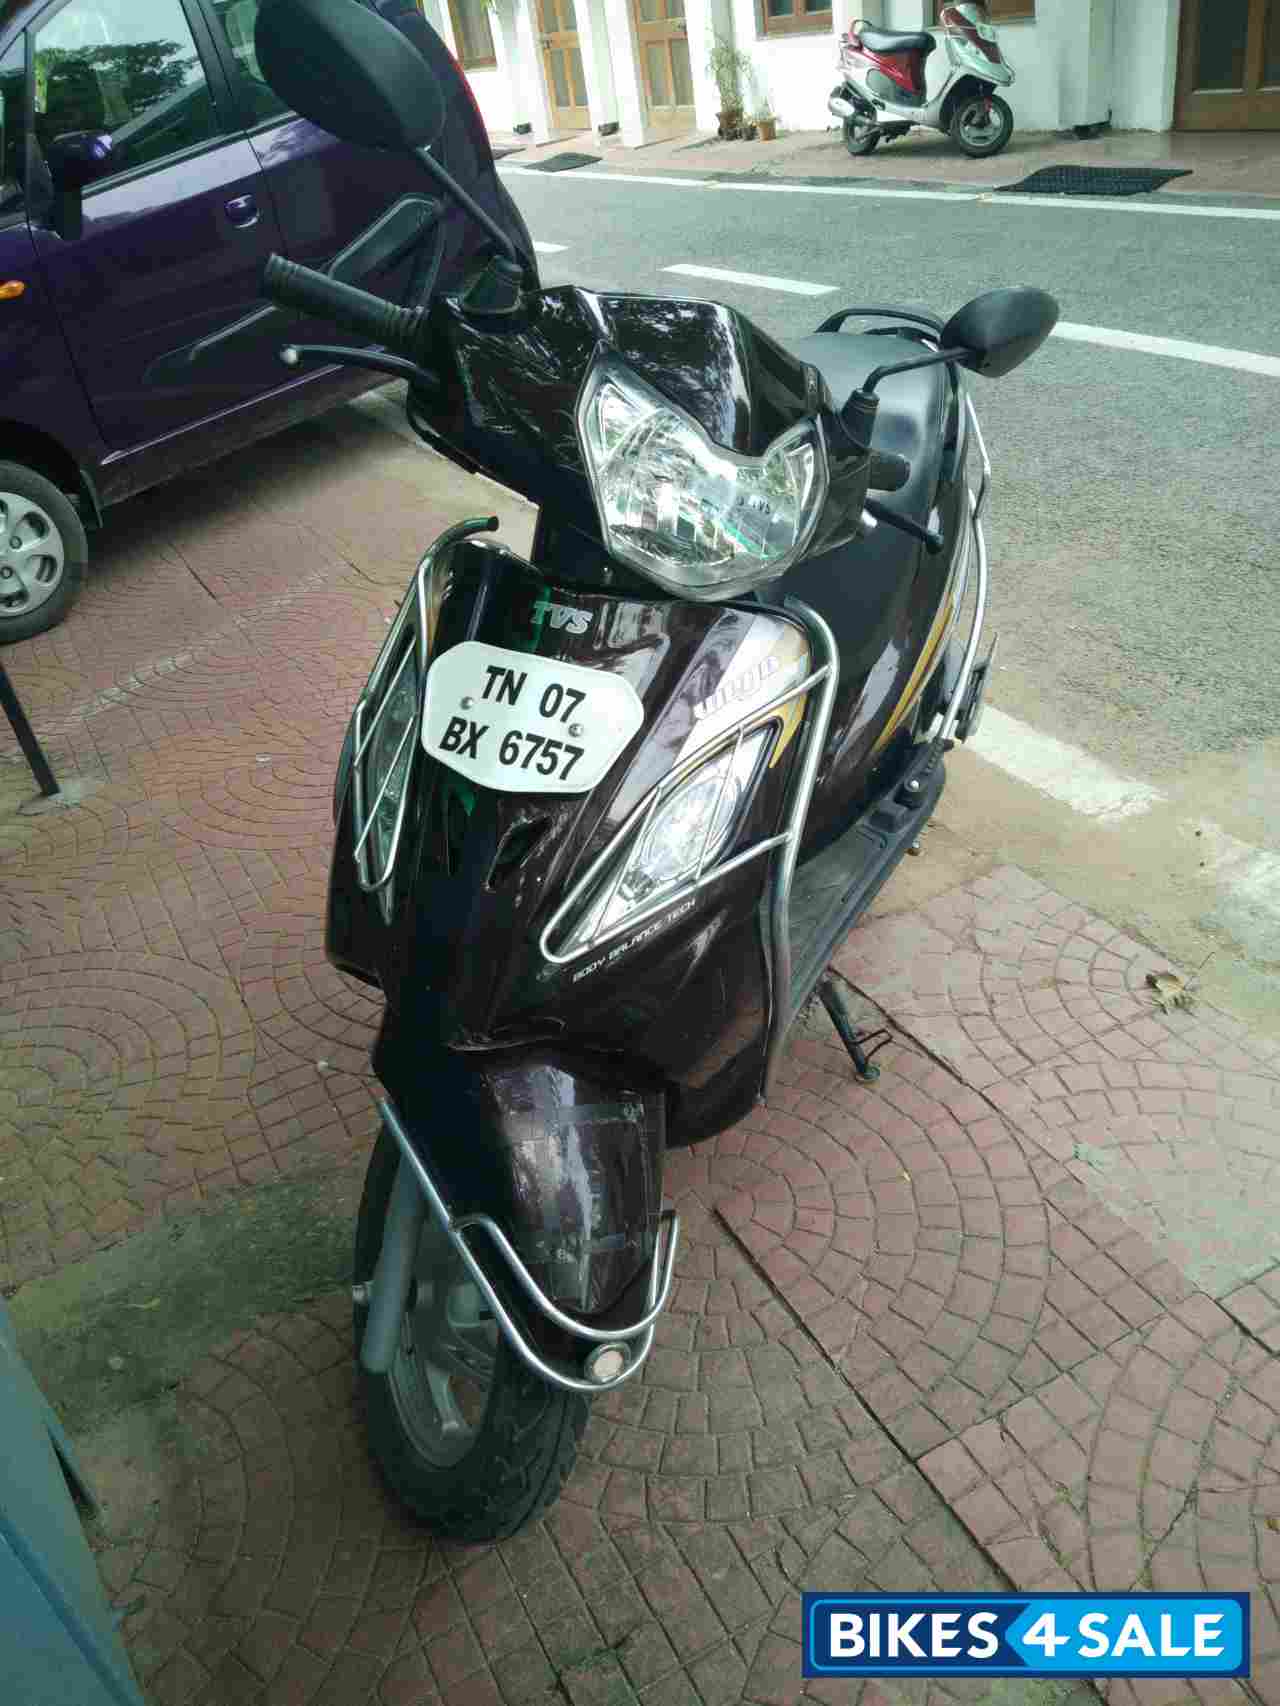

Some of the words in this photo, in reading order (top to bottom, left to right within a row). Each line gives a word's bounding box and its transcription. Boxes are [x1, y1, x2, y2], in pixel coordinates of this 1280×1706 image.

[530, 601, 593, 634] TVS
[481, 665, 527, 706] TN
[539, 683, 586, 723] 07
[439, 717, 490, 759] BX
[498, 730, 584, 781] 6757
